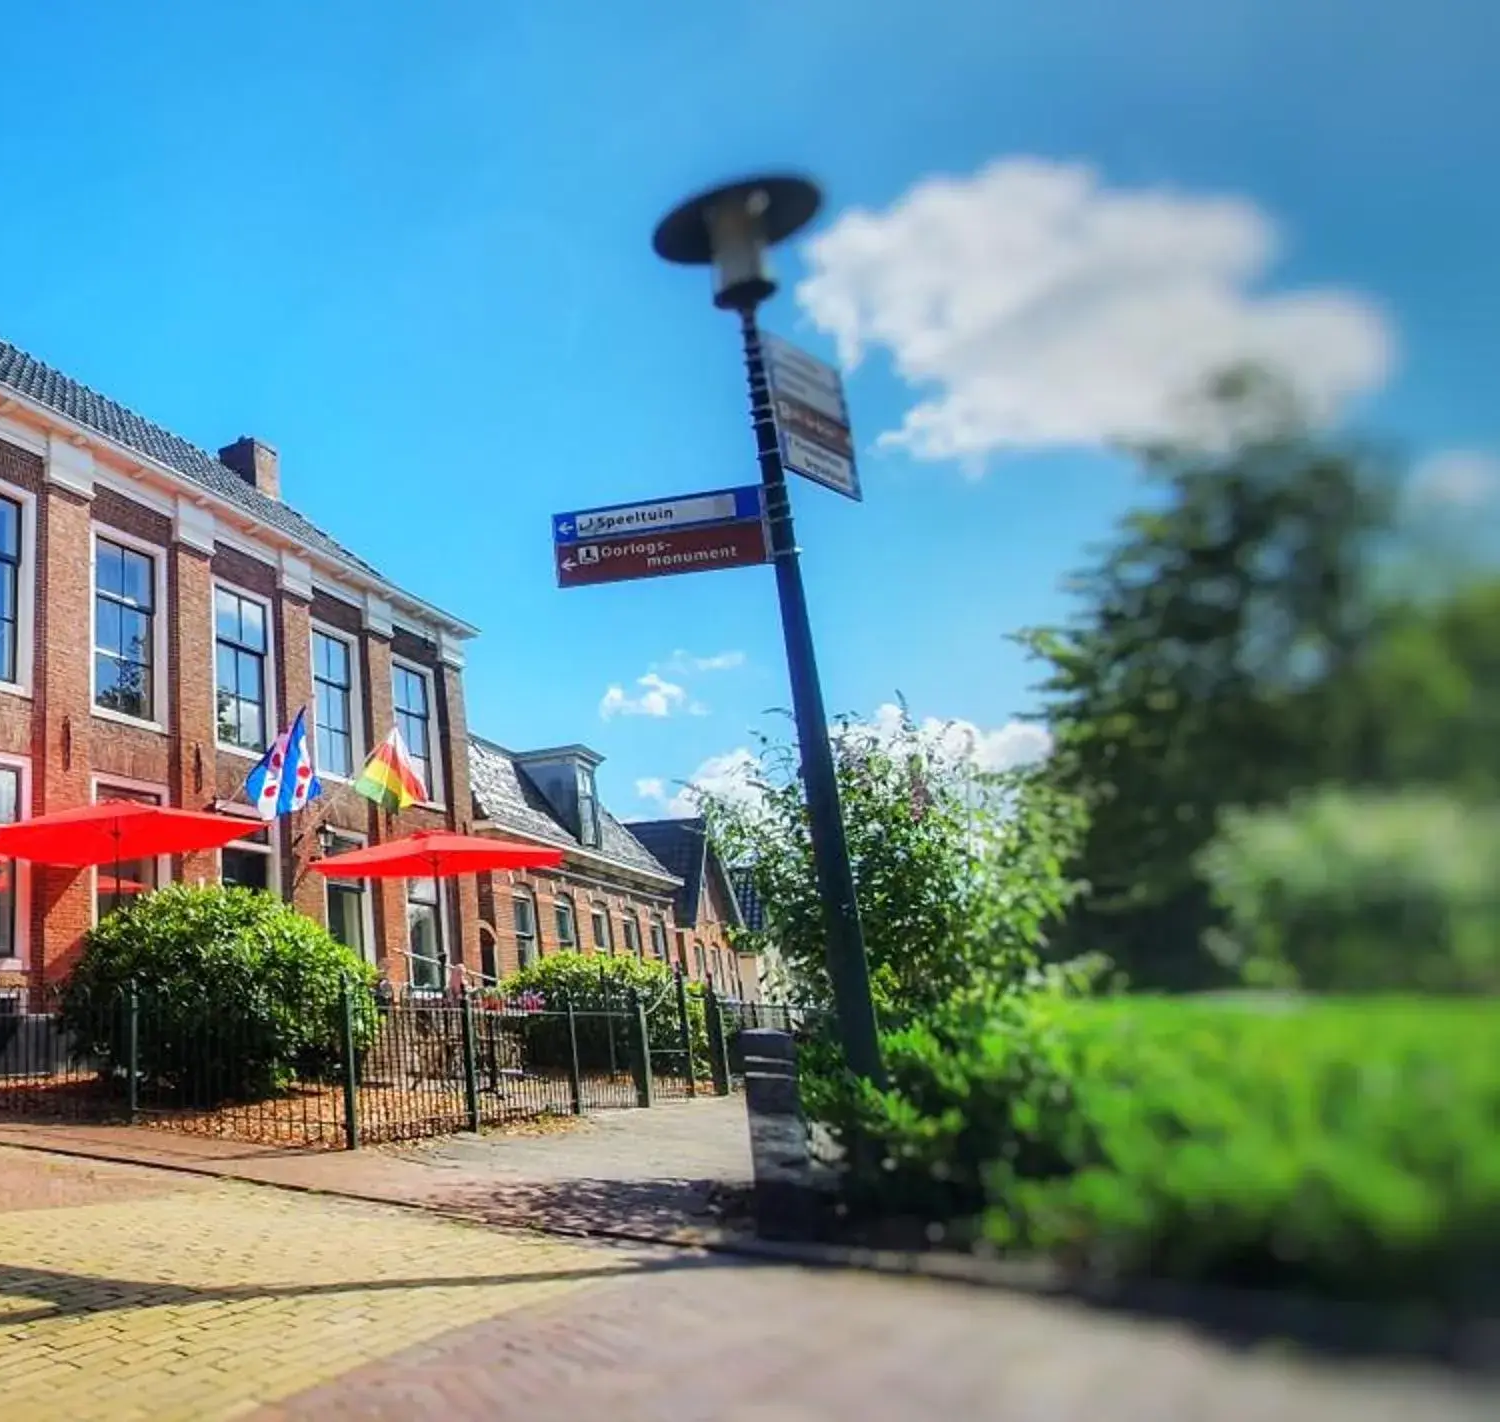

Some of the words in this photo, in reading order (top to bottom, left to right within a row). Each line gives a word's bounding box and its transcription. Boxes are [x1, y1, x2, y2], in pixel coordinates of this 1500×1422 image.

[598, 507, 673, 529] Speeltuin
[601, 541, 672, 557] Oorlogs-
[647, 546, 737, 567] monument
